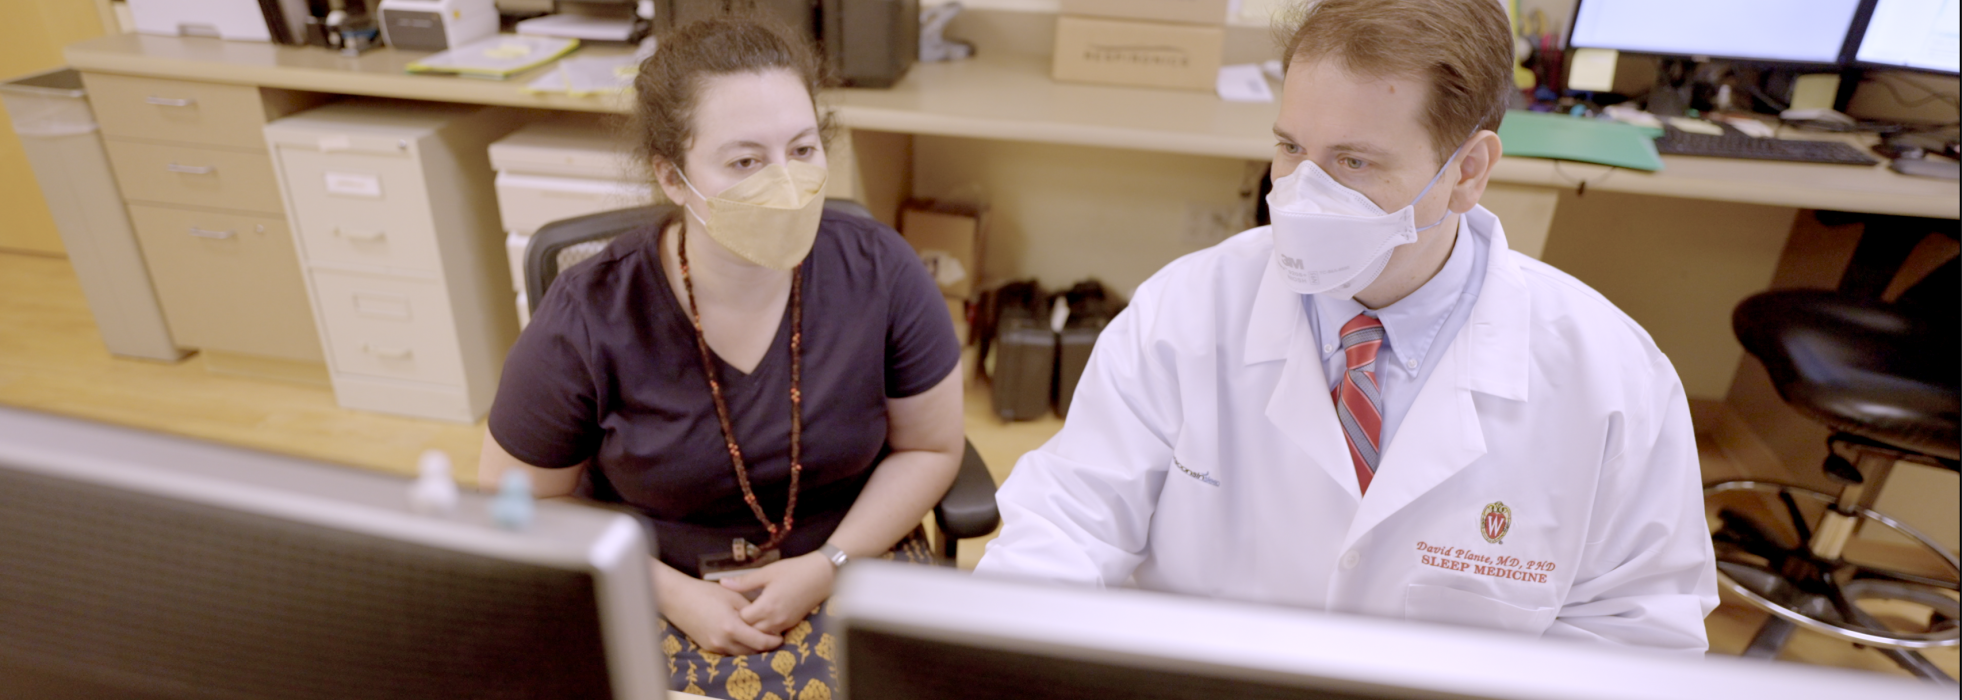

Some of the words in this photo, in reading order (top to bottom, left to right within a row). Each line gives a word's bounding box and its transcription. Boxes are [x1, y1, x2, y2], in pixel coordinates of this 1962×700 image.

[1281, 253, 1304, 270] 3M
[1488, 515, 1505, 537] W
[1416, 541, 1455, 557] David
[1455, 548, 1493, 565] Plante,
[1495, 555, 1523, 570] MD,
[1526, 560, 1556, 572] PHD
[1421, 554, 1470, 572] SLEEP
[1473, 564, 1548, 584] MEDICINE
